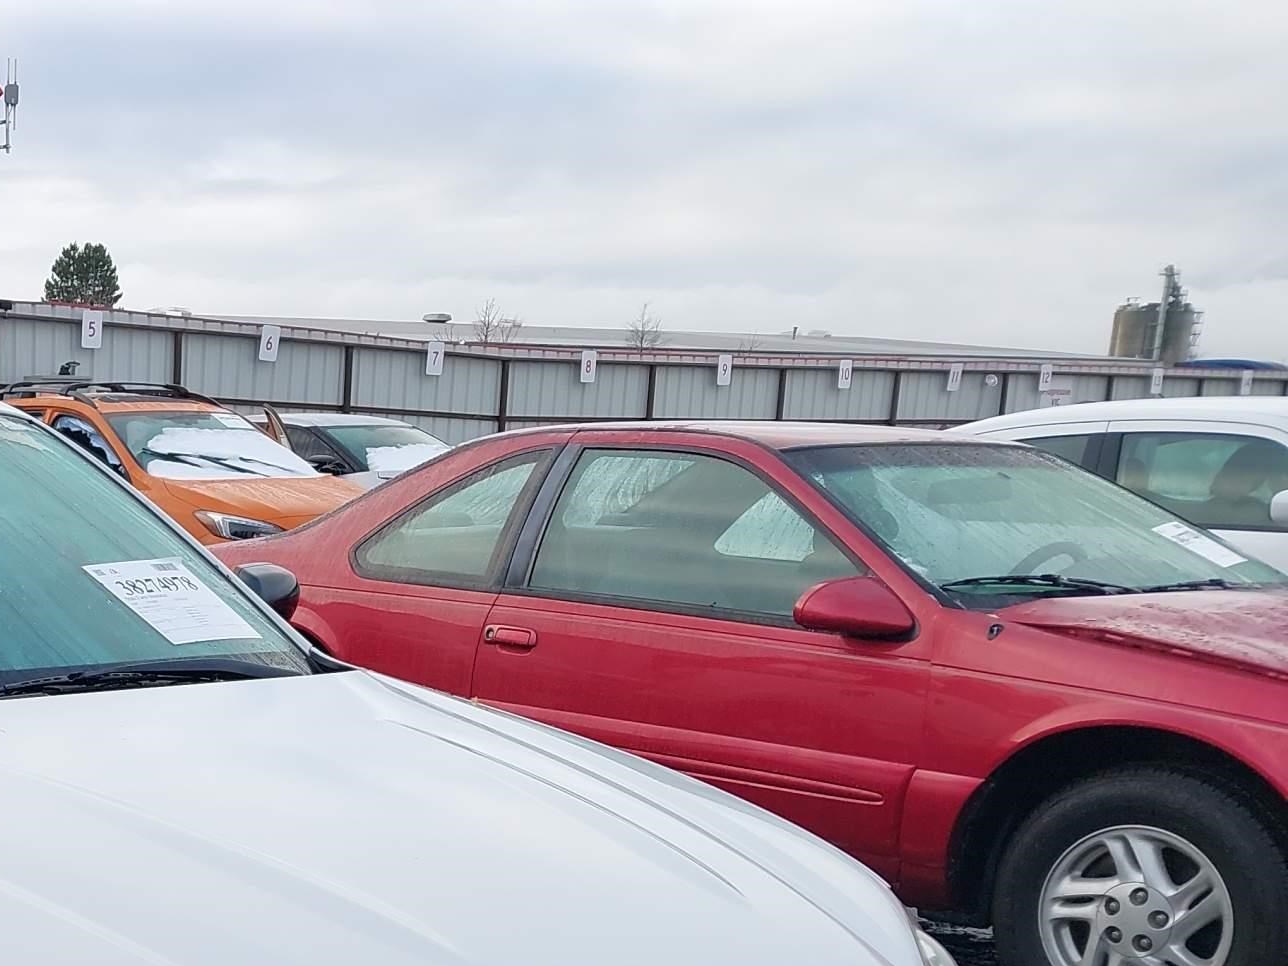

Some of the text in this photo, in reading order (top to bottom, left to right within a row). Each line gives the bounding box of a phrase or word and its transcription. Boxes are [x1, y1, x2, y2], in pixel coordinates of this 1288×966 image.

[88, 320, 96, 337] 5
[265, 335, 273, 351] 6
[432, 351, 440, 366] 7
[585, 359, 592, 374] 8
[722, 363, 728, 377] 9
[840, 367, 850, 380] 10
[951, 370, 960, 383] 11
[1042, 372, 1050, 384] 12
[115, 576, 198, 596] 38274978
